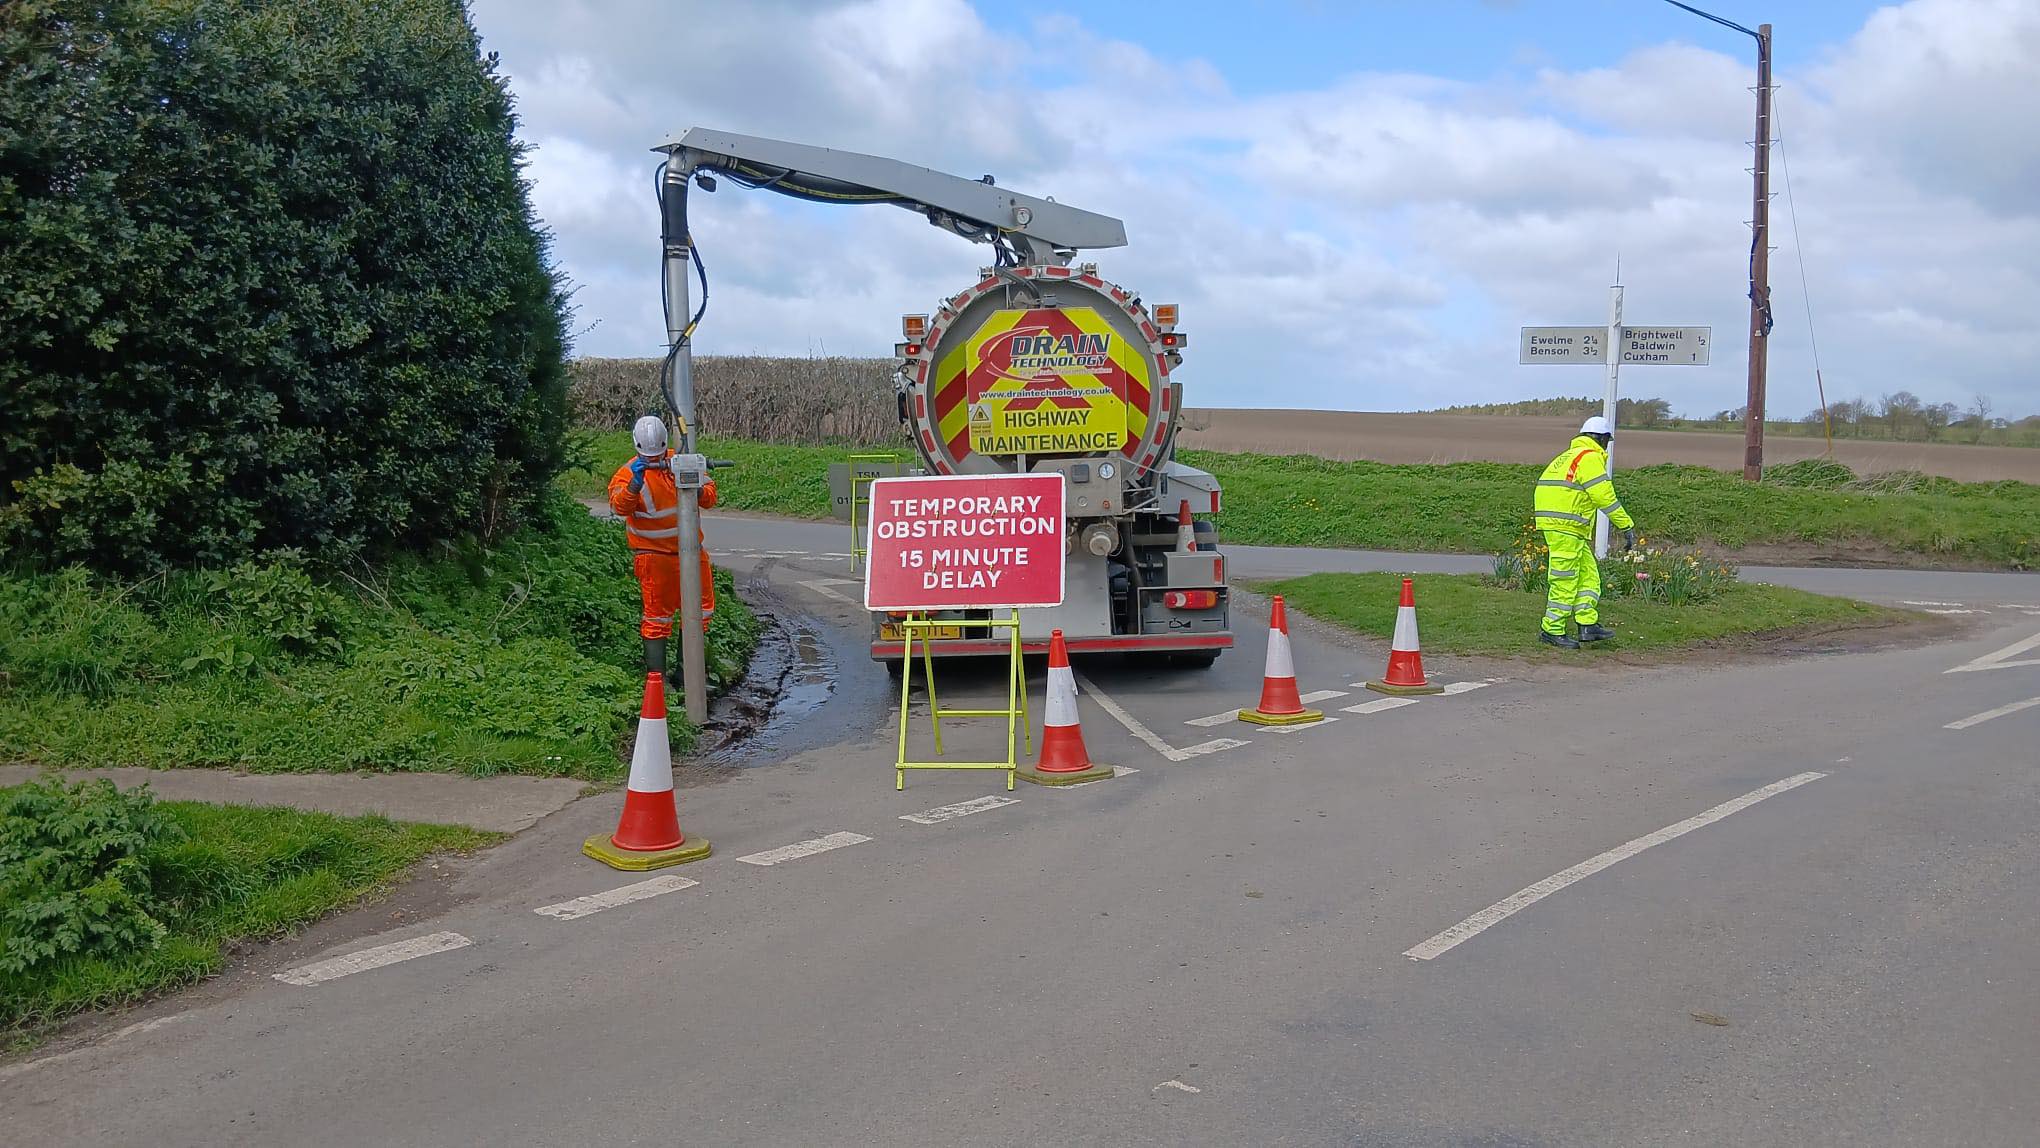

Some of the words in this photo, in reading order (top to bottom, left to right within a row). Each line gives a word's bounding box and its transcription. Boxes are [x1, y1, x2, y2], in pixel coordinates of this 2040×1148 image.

[1531, 336, 1573, 345] Ewelme
[1625, 330, 1683, 341] Brightwell
[1011, 334, 1111, 356] DRAIN
[1530, 347, 1570, 356] Benson
[1631, 341, 1676, 350] Baldwin
[1011, 355, 1107, 368] TECHNOLOGY
[1624, 352, 1669, 361] Cuxham
[1692, 353, 1696, 362] 1
[980, 387, 1112, 399] www.draintechnology.co.uk
[1005, 410, 1090, 428] HIGHWAY
[979, 432, 1118, 453] MAINTENANCE
[890, 495, 1042, 517] TEMPORARY
[877, 517, 1055, 539] OBSTRUCTION
[900, 550, 923, 568] 15
[932, 548, 1029, 567] MINUTE
[923, 570, 1002, 590] DELAY
